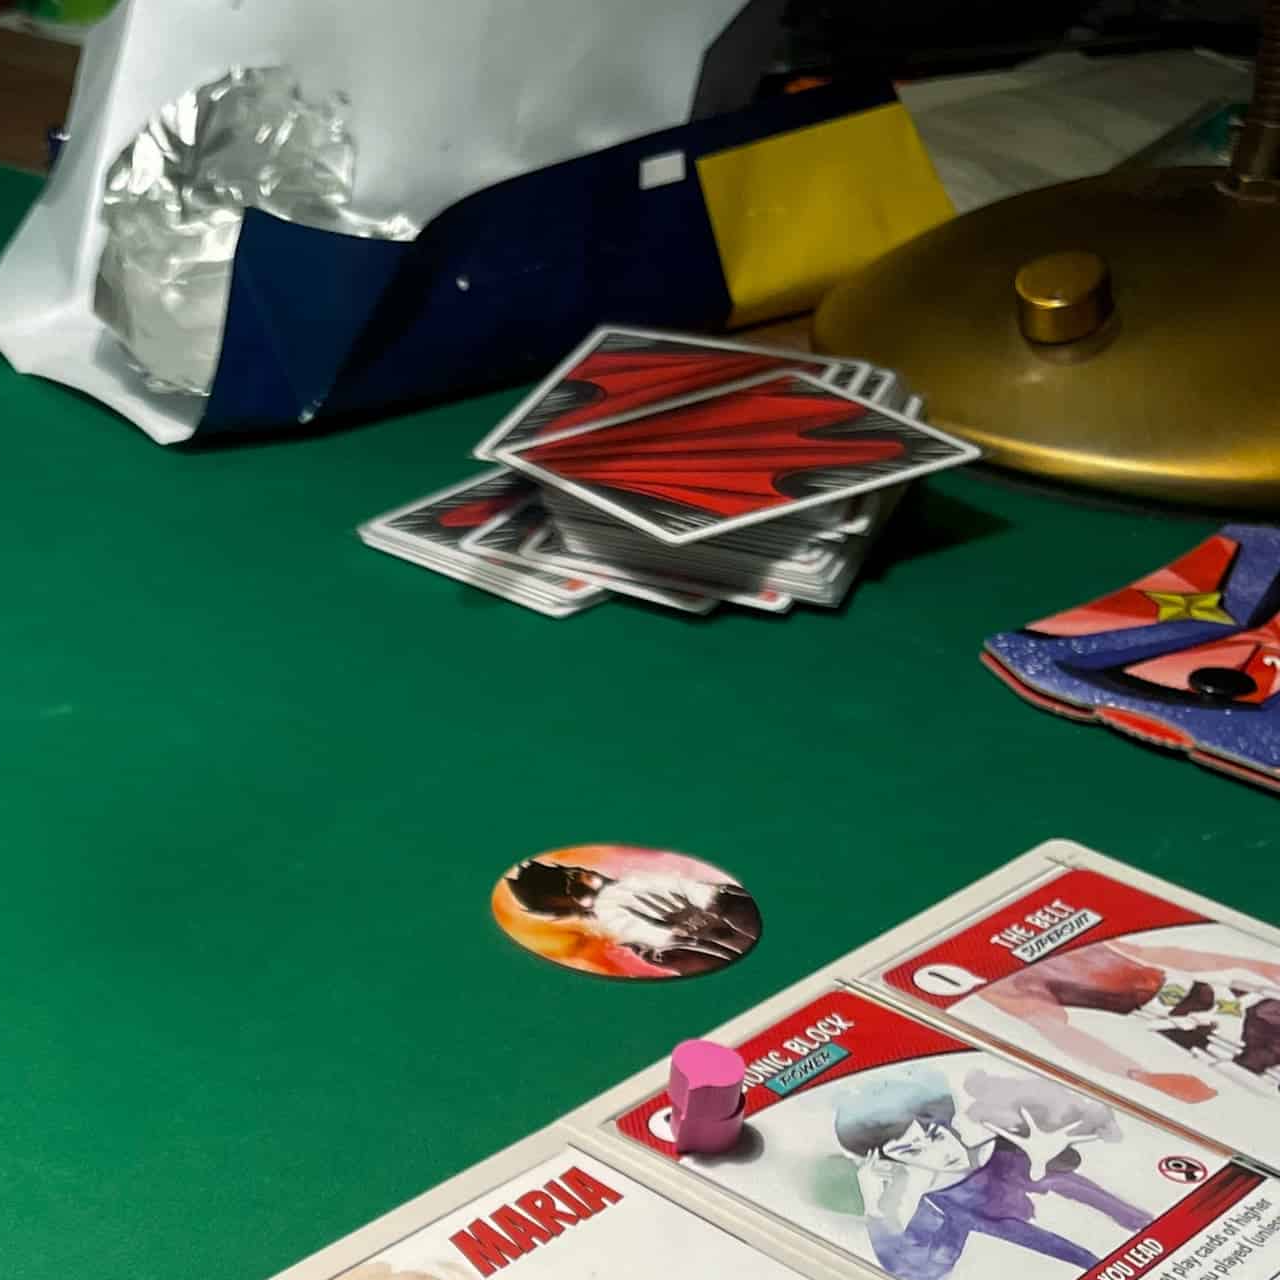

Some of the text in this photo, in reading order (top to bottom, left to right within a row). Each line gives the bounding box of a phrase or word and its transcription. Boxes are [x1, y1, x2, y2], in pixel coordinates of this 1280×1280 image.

[990, 898, 1075, 949] THE BELT
[782, 1013, 855, 1056] BLOCK
[449, 1166, 624, 1278] MARIA
[1228, 1198, 1272, 1226] higher
[1223, 1221, 1241, 1237] of
[1124, 1238, 1164, 1269] LEAD
[1195, 1234, 1228, 1258] cards
[1214, 1241, 1253, 1276] played
[1172, 1256, 1202, 1278] play
